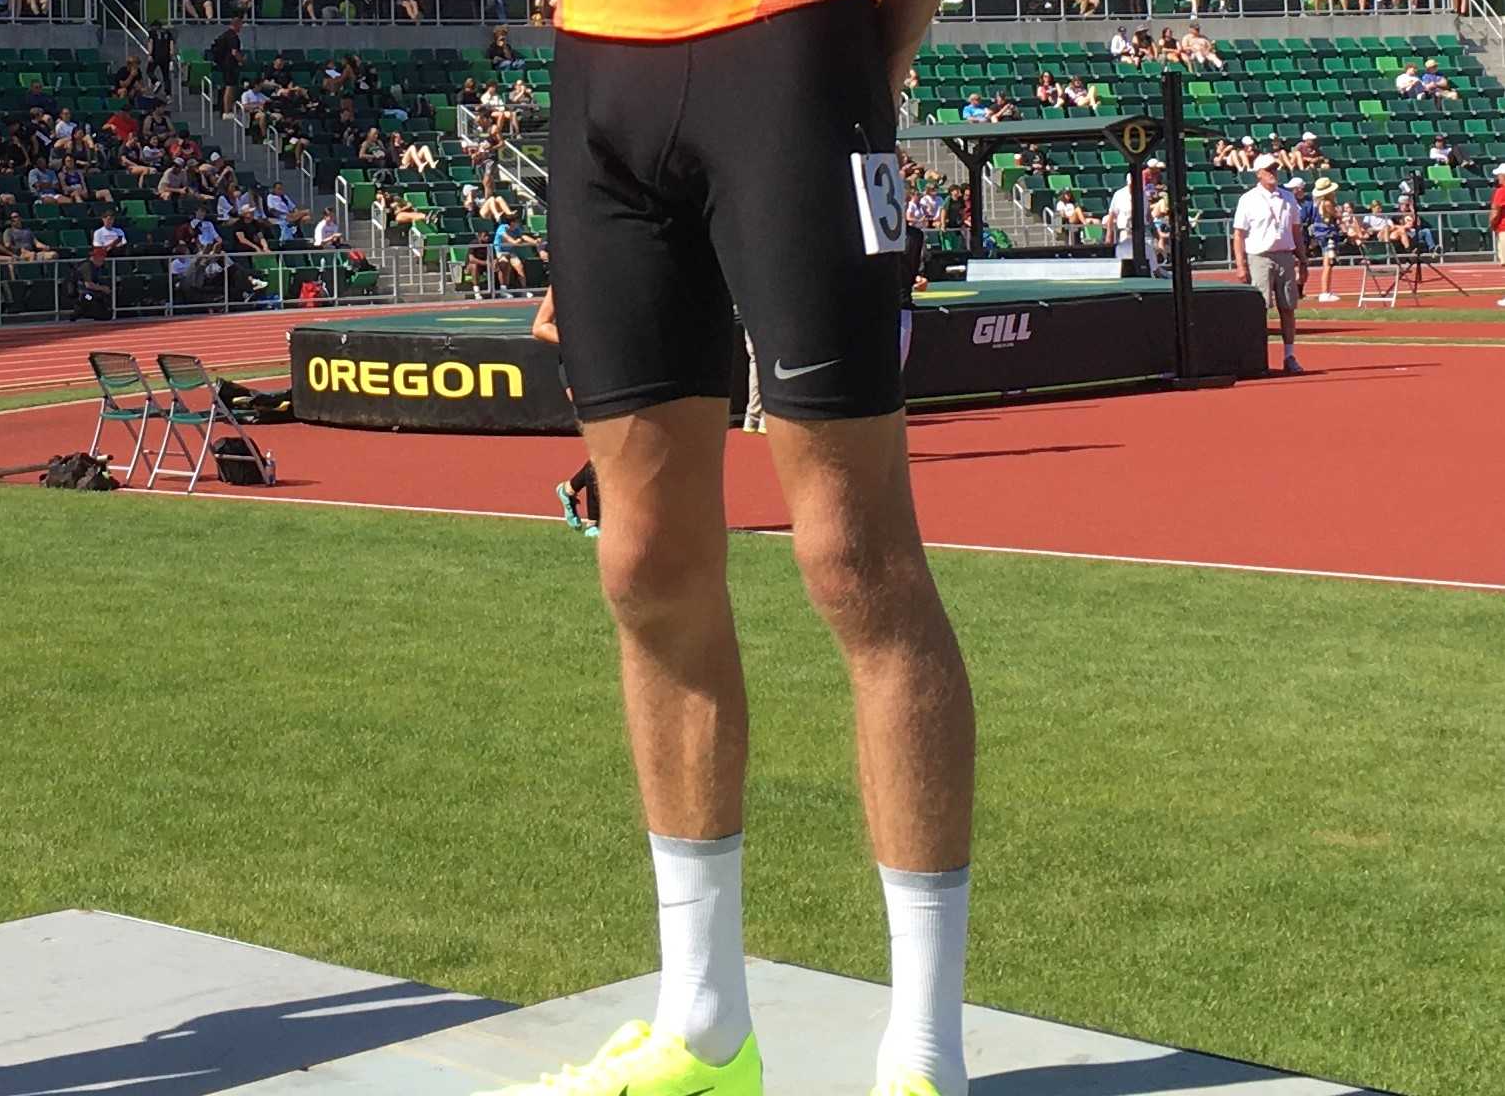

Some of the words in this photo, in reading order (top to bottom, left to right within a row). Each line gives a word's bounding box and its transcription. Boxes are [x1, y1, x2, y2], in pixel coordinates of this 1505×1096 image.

[873, 162, 903, 242] 3
[973, 312, 1032, 345] GILL
[308, 356, 523, 399] OREGON
